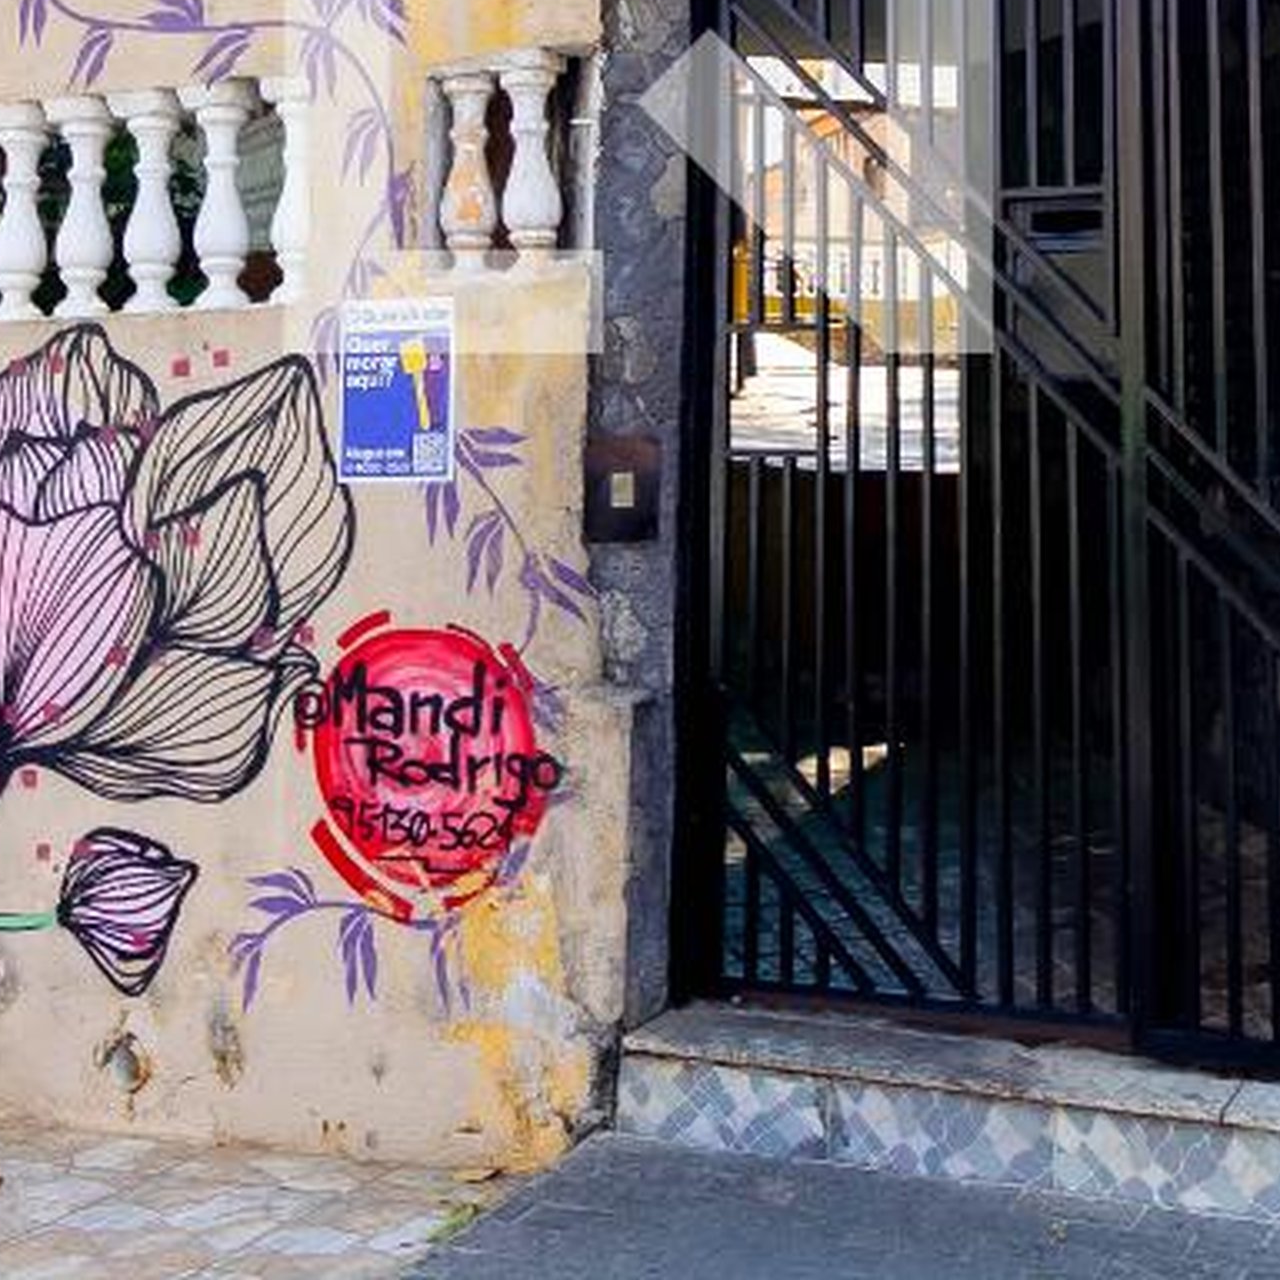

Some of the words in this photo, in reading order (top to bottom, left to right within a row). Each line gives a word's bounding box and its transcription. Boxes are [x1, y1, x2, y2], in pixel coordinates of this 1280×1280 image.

[346, 356, 398, 371] morar
[346, 372, 393, 391] aqui?
[294, 660, 506, 739] @Mandi
[343, 731, 561, 808] Rodrigo
